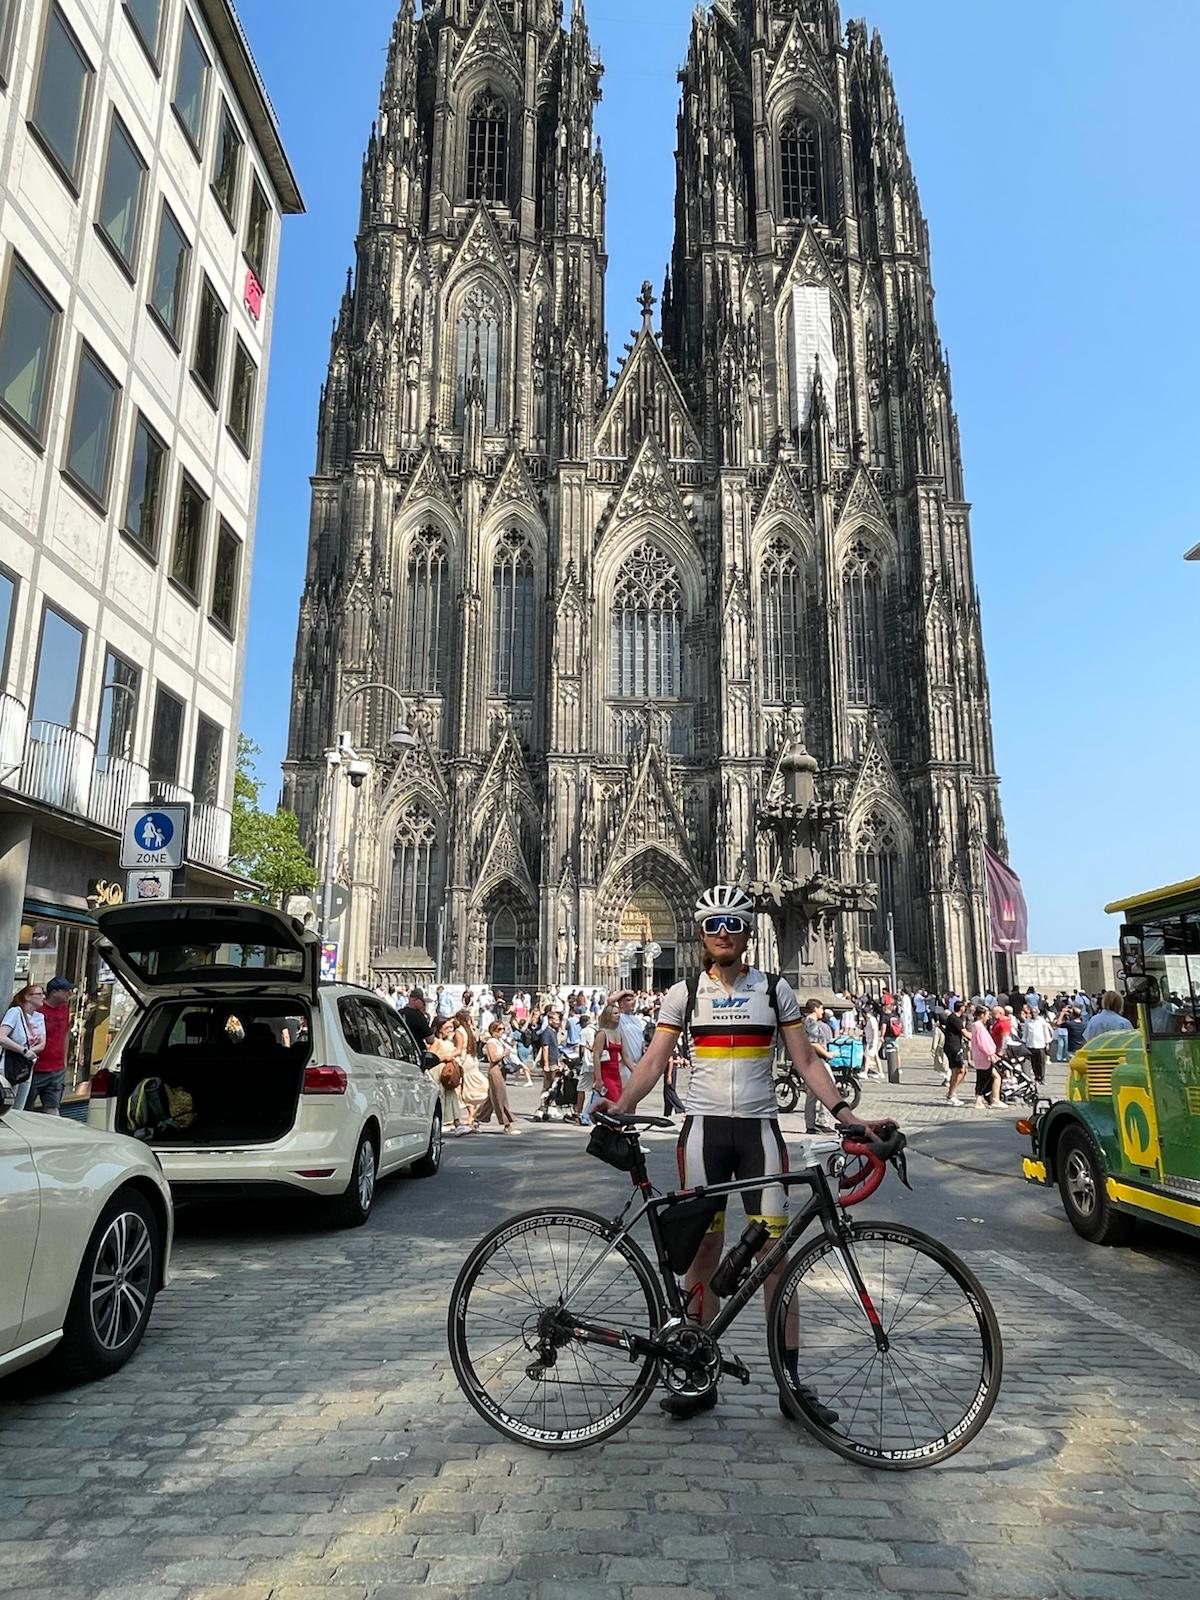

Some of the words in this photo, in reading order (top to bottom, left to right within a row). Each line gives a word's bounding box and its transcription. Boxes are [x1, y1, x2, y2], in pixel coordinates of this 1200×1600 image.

[136, 853, 167, 864] ZONE
[496, 1217, 553, 1247] AMERICAN
[782, 1249, 823, 1305] AMERICAN
[560, 1406, 622, 1440] AMERICAN
[946, 1382, 990, 1444] AMERICAN
[507, 1418, 559, 1440] CLASSIC
[892, 1437, 946, 1460] CLASSIC
